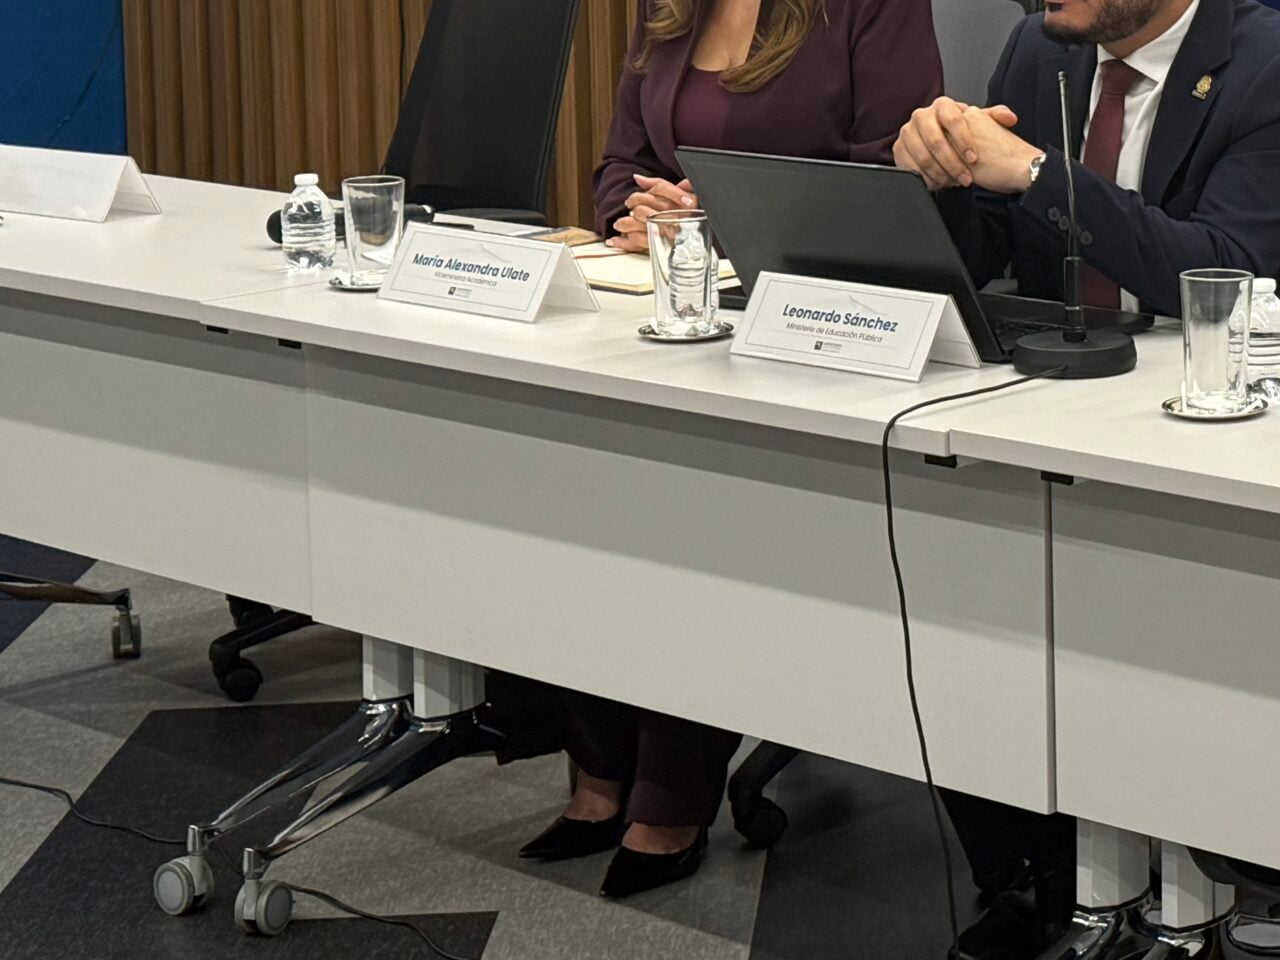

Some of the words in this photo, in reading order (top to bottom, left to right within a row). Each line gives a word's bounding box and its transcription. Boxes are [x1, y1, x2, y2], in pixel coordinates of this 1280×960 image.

[412, 253, 444, 268] María
[444, 258, 500, 277] Alexandra
[501, 266, 530, 281] Ulate
[782, 304, 841, 323] Leonardo
[842, 312, 899, 332] Sánchez
[785, 322, 815, 333] Ministerio
[815, 326, 825, 334] de
[825, 327, 858, 339] Educación
[858, 332, 883, 343] Pública
